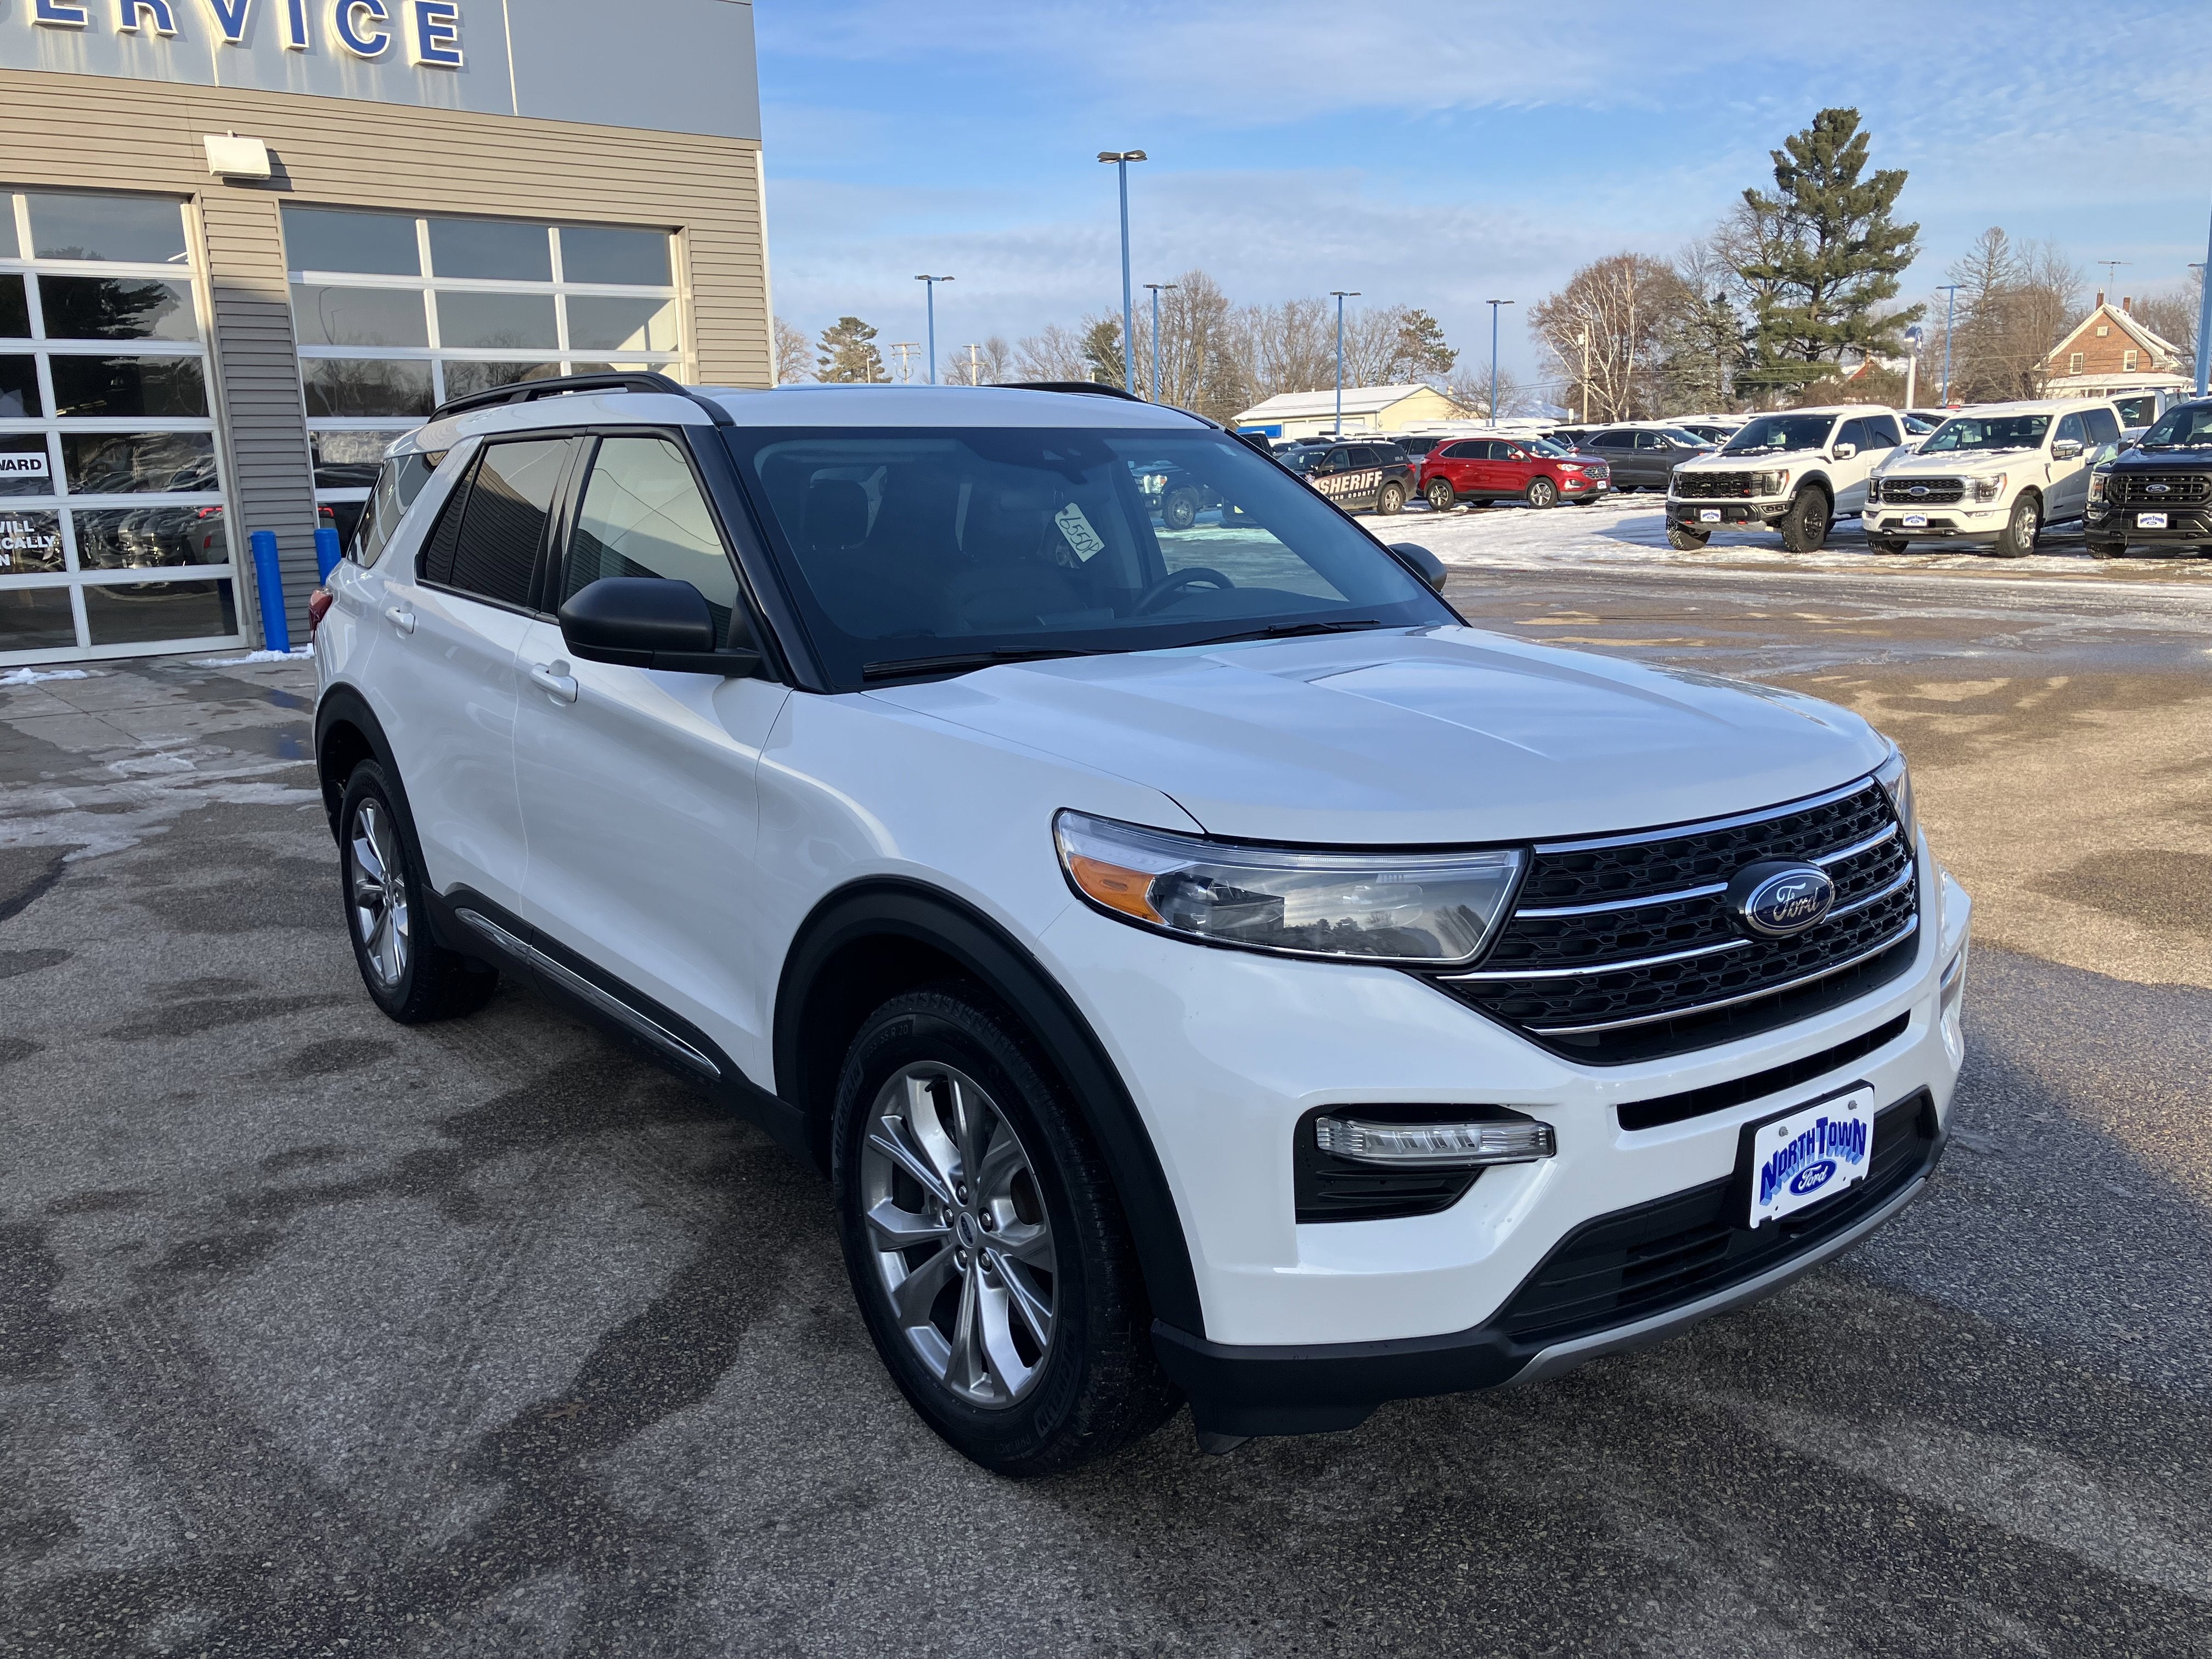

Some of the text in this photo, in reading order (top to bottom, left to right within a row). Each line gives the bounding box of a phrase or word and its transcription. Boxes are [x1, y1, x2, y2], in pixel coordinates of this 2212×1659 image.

[1320, 471, 1383, 494] SHERIFF
[1348, 490, 1375, 499] COUNTY
[0, 535, 55, 550] CALLY
[1059, 517, 1101, 554] 6550P
[1773, 882, 1820, 922] Ford
[1798, 1165, 1829, 1191] Ford
